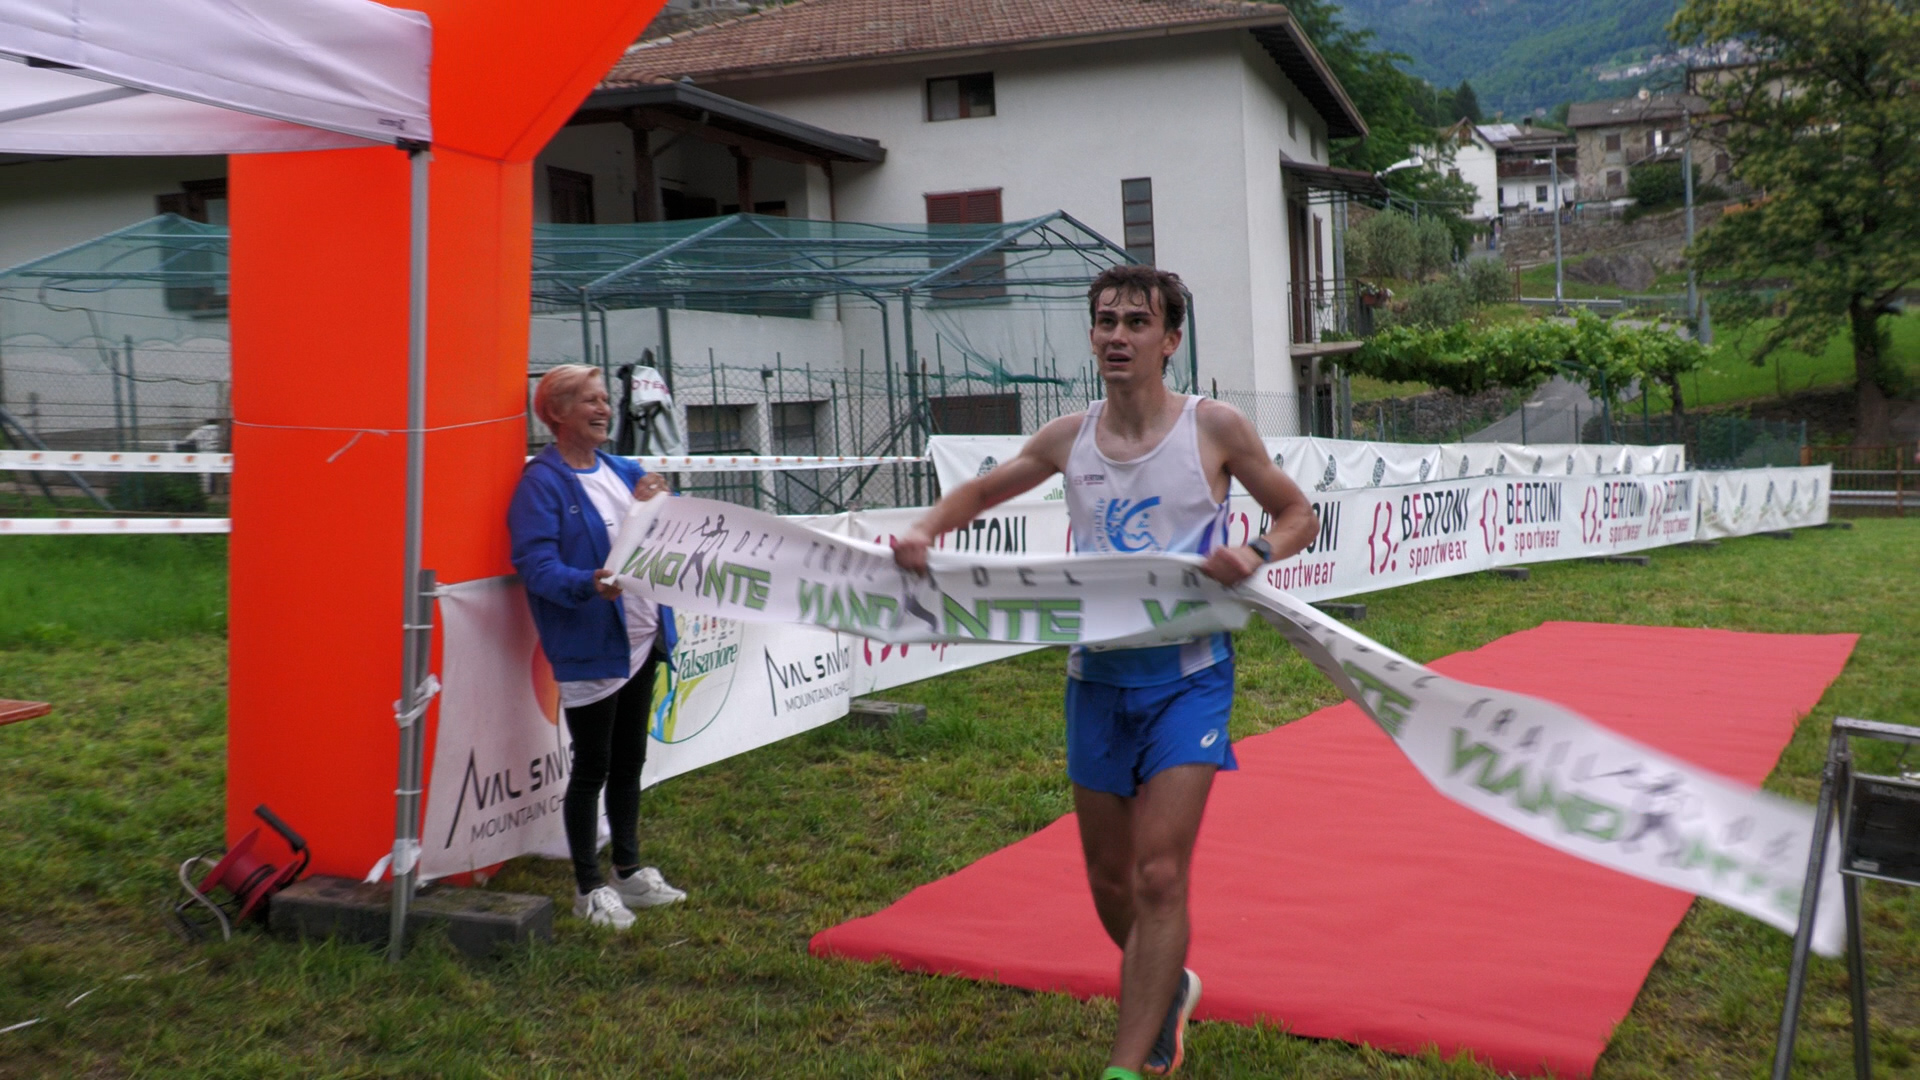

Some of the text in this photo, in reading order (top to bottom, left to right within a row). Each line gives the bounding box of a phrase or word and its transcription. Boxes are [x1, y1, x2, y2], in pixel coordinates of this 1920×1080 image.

[1401, 487, 1470, 542] BERTONI
[1506, 481, 1562, 525] BERTONI
[1409, 540, 1467, 575] sportwear
[1514, 527, 1560, 557] sportwear
[470, 800, 547, 843] MOUNTAIN
